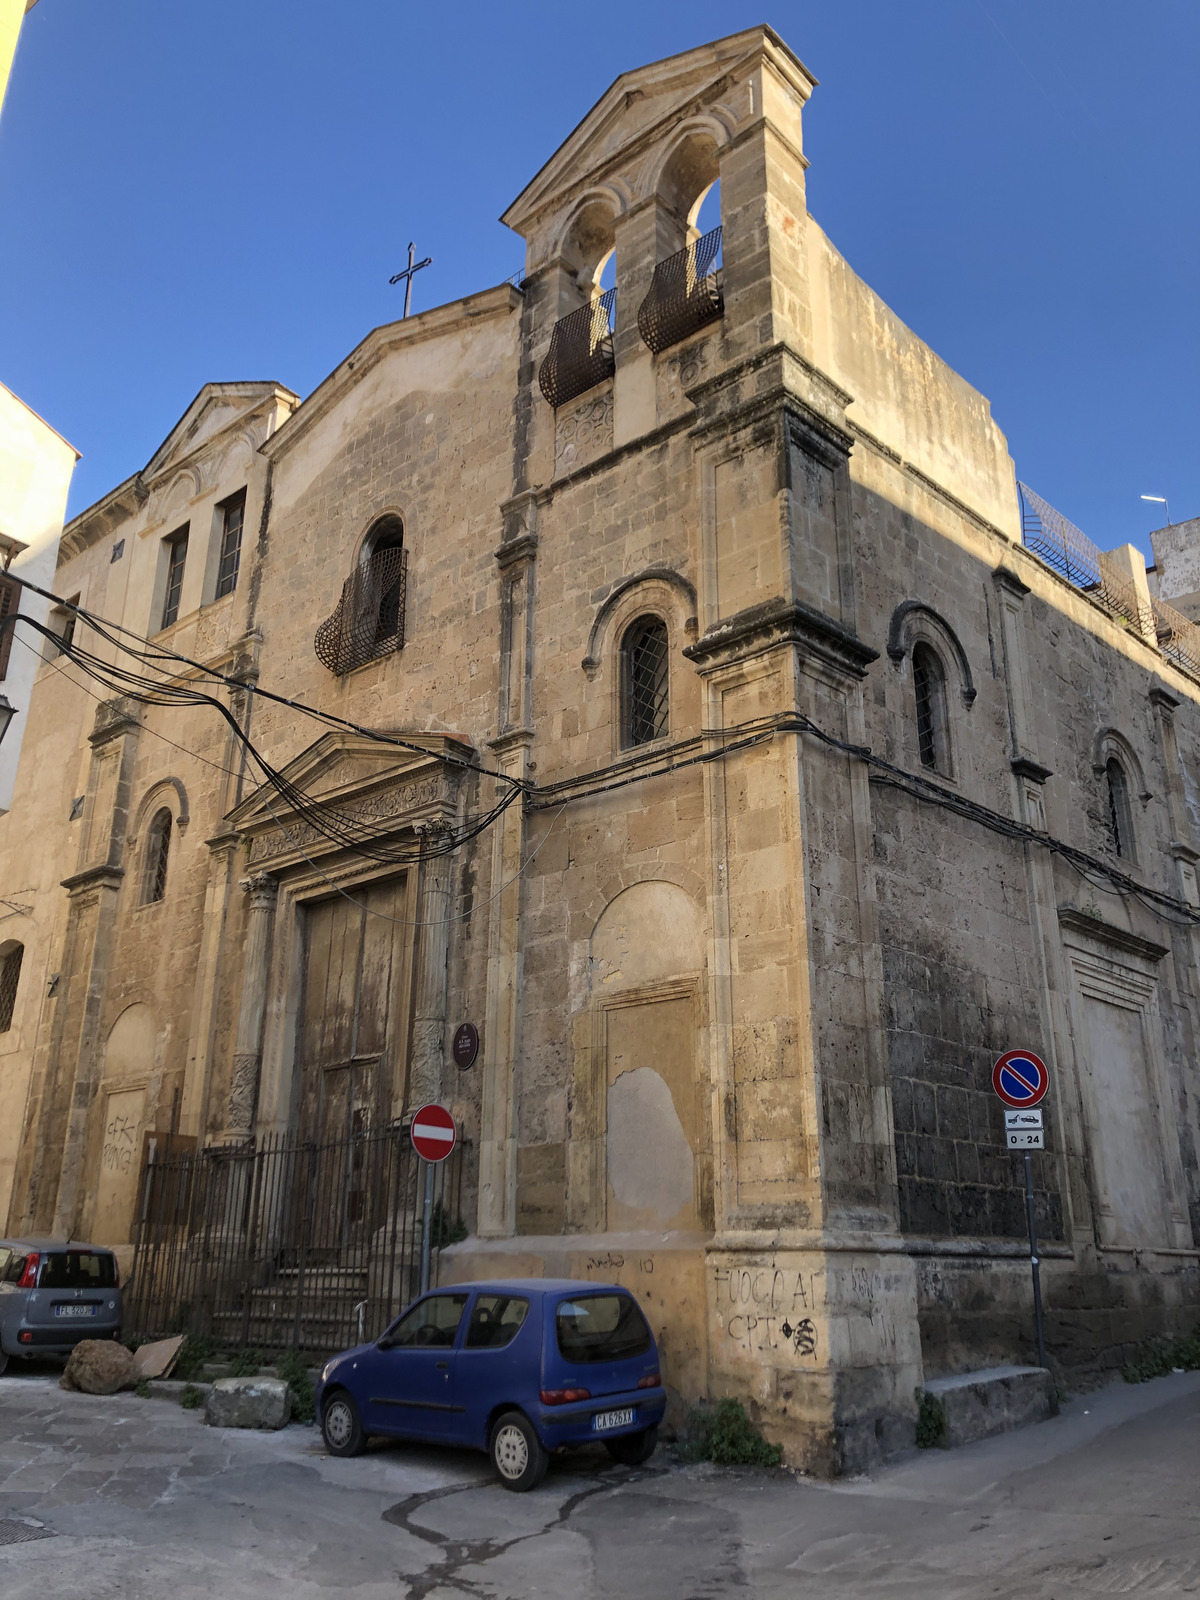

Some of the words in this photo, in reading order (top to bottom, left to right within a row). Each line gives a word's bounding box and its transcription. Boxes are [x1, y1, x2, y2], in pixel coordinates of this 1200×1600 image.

[1010, 1136, 1017, 1144] 0
[1026, 1136, 1040, 1144] 24
[714, 1267, 785, 1310] FUOCO
[597, 1414, 607, 1428] CA
[608, 1409, 632, 1426] 626XX
